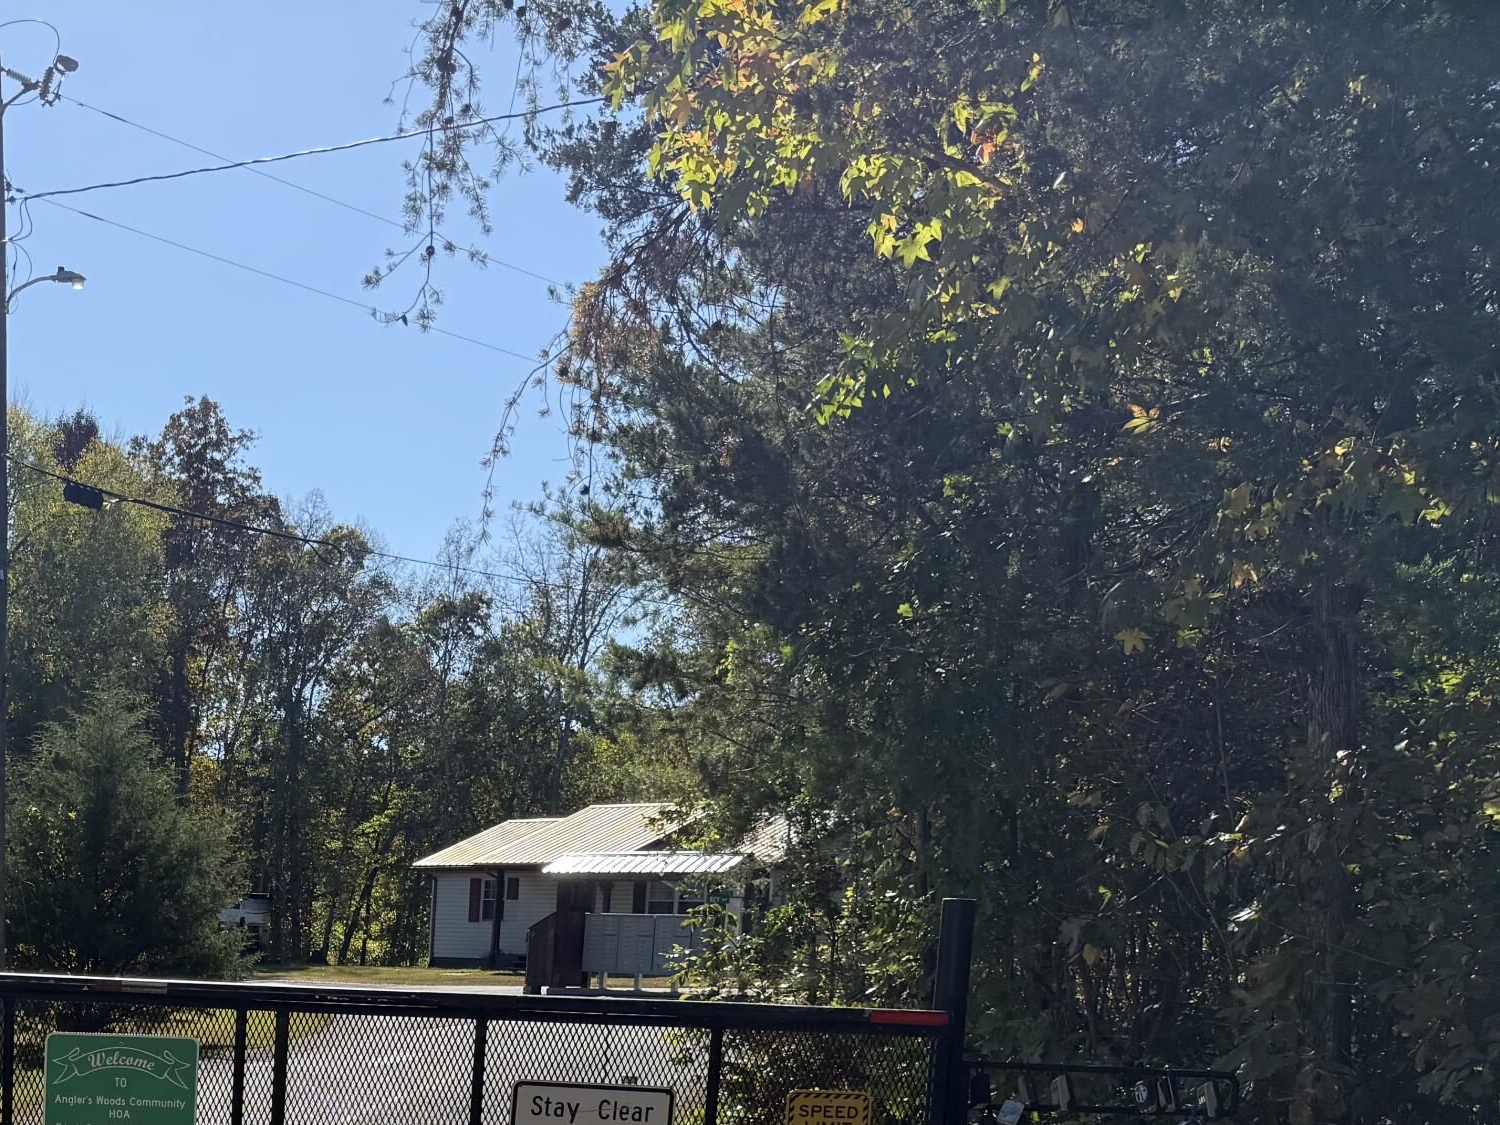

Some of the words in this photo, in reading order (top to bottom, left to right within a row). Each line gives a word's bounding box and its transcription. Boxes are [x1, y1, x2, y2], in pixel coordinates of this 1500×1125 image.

[87, 1051, 156, 1070] Welcome
[114, 1077, 127, 1088] TO
[54, 1094, 93, 1106] Angler's
[96, 1095, 126, 1106] Woods
[129, 1097, 186, 1110] Community
[530, 1095, 581, 1124] Stay
[598, 1099, 654, 1123] Clear
[108, 1110, 130, 1119] HOA
[798, 1104, 859, 1119] SPEED
